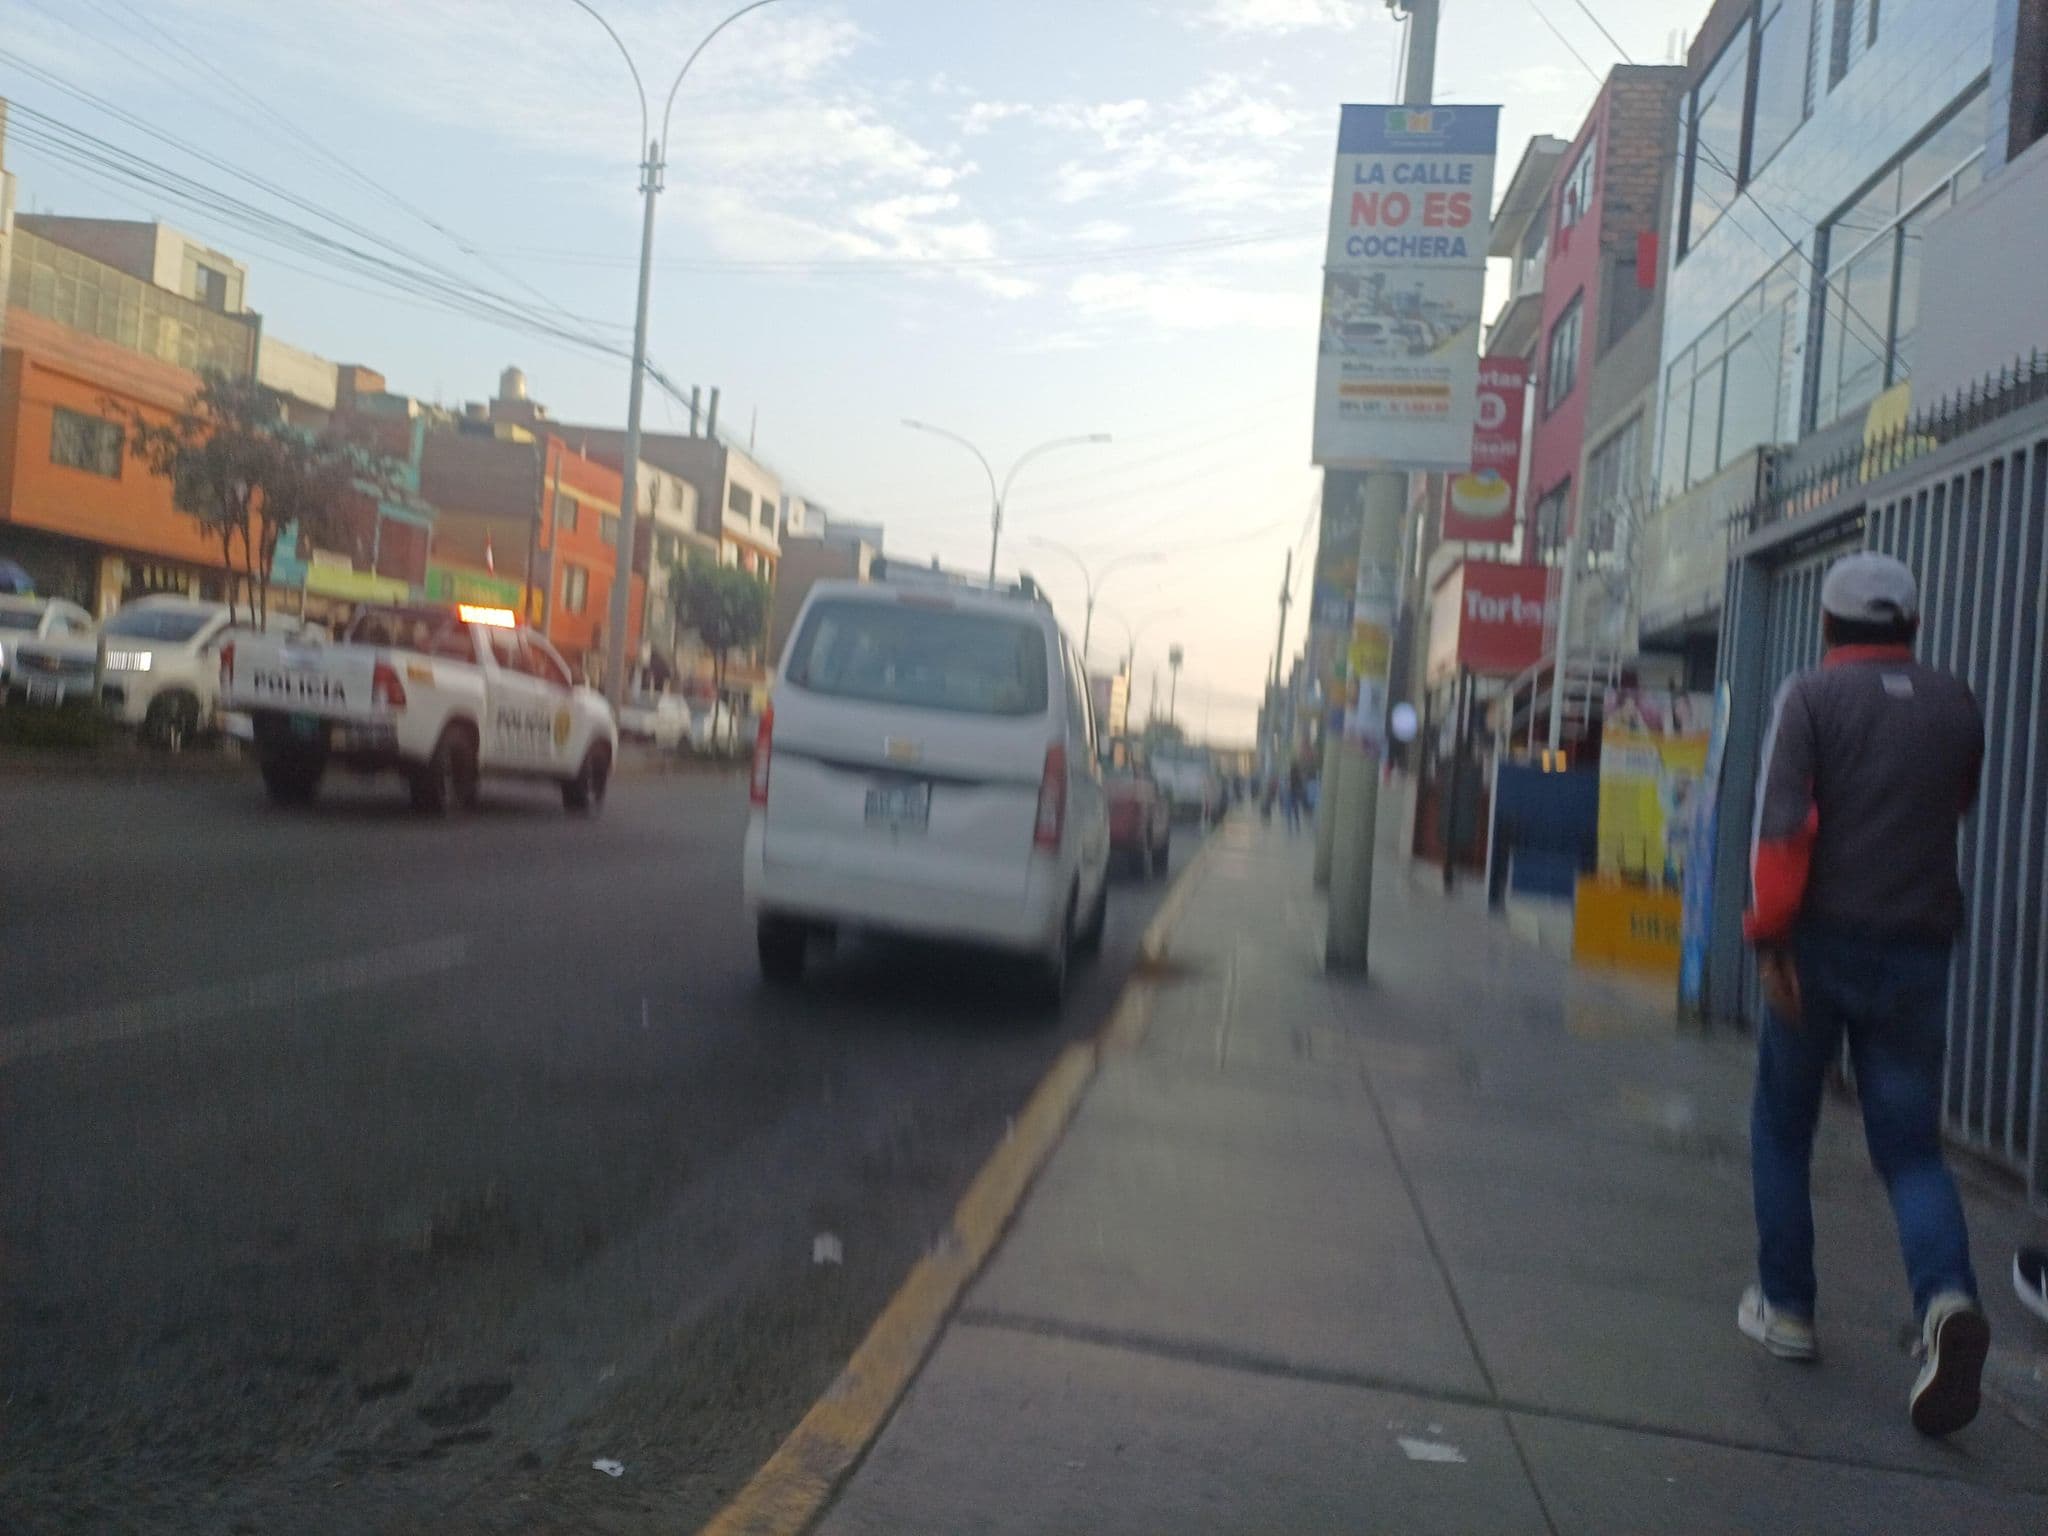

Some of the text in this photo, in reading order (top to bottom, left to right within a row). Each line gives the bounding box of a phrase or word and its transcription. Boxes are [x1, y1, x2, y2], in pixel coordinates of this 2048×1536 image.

[1354, 163, 1472, 184] LA CALLE
[1350, 191, 1472, 228] NO ES
[1346, 235, 1467, 257] COCHERA
